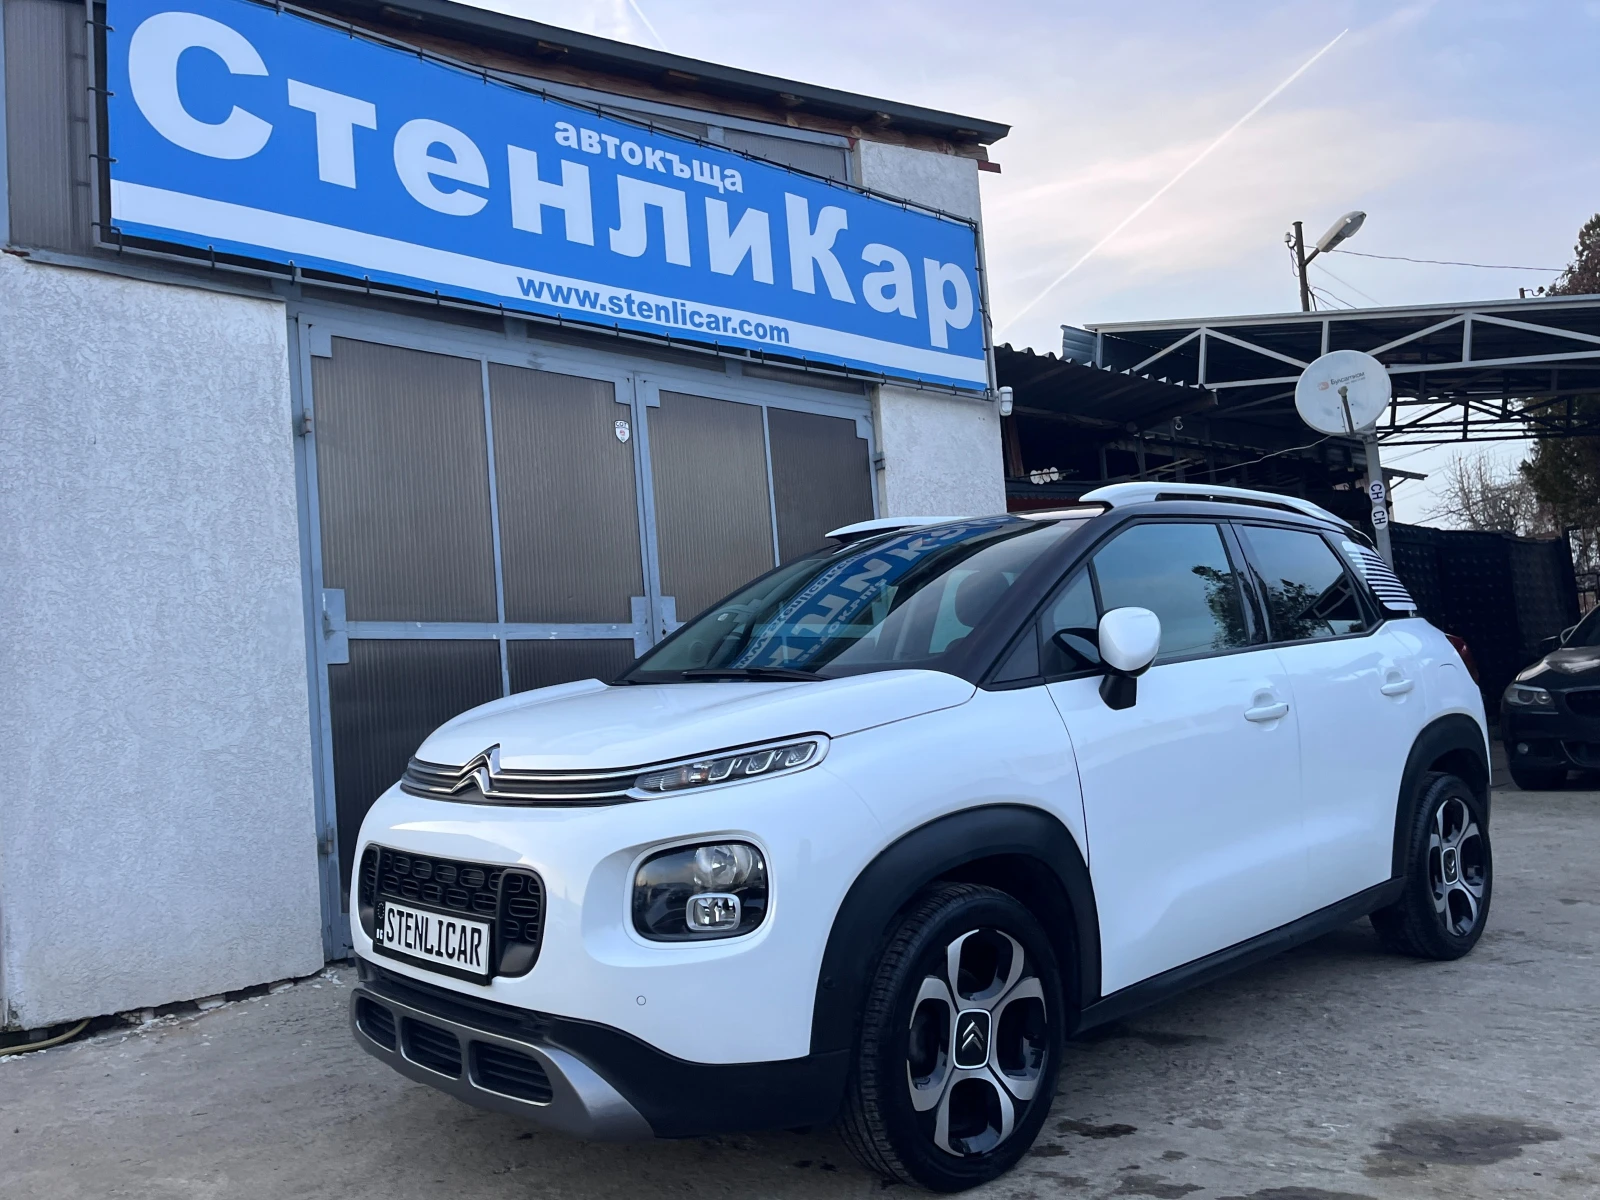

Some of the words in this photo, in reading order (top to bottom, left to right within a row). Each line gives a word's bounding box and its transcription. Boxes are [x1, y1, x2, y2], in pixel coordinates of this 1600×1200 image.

[127, 11, 974, 349] СтенлиКар
[554, 120, 743, 194] автокъща
[516, 275, 790, 344] www.stenlicar.com
[1370, 483, 1385, 500] CH
[1372, 510, 1387, 526] CH
[386, 907, 482, 967] STENLICAR
